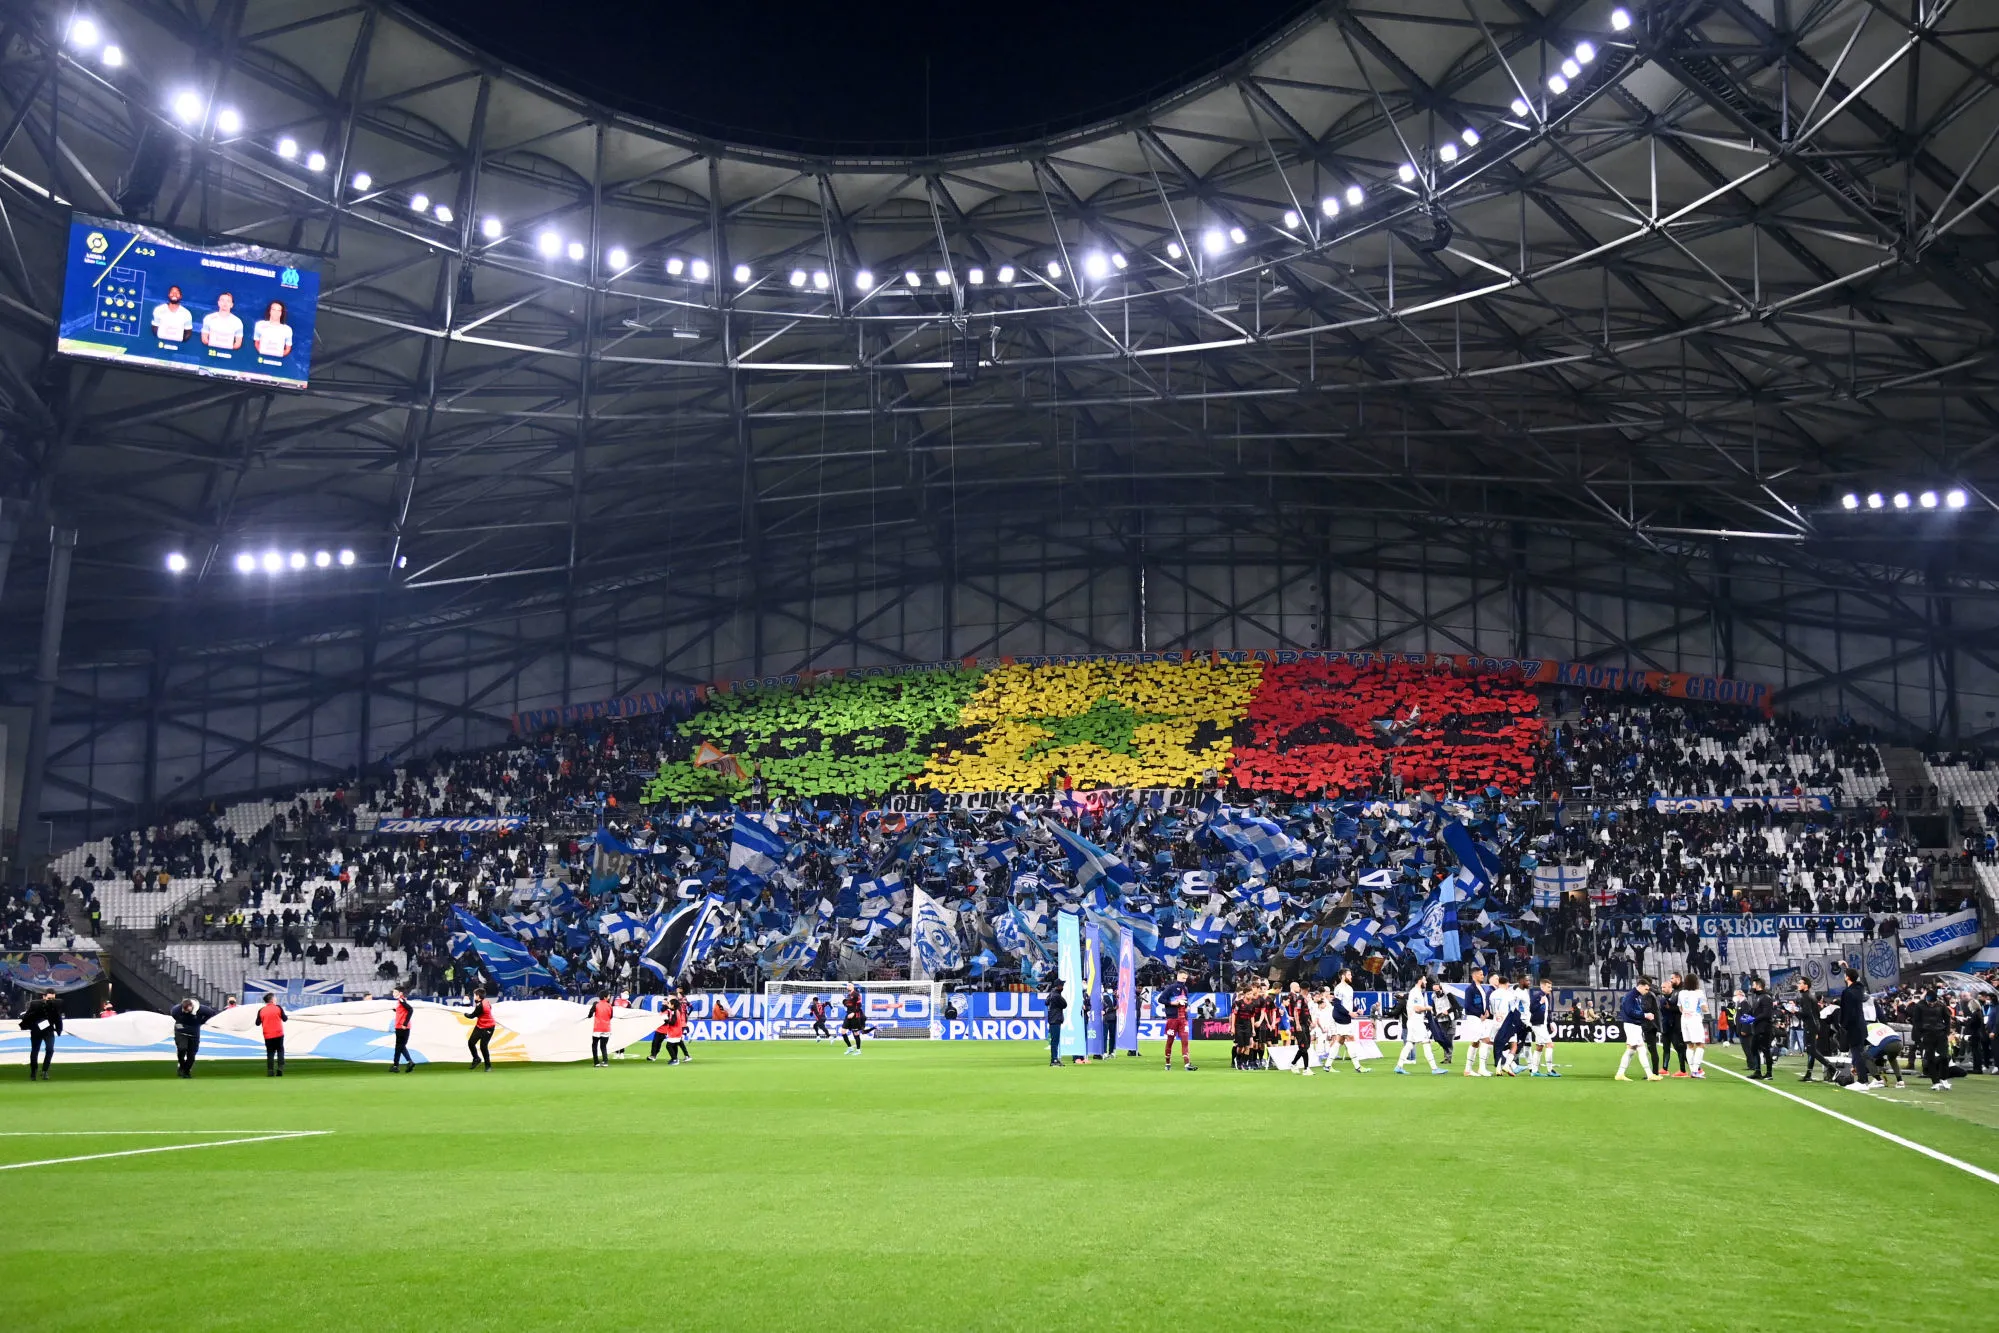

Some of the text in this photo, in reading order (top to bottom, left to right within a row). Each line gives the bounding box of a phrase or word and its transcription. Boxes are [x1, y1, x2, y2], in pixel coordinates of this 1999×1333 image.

[1557, 662, 1645, 692] KAOTIC
[1685, 676, 1767, 701] GROUP
[379, 819, 442, 832] ZONE
[949, 1020, 1049, 1040] PARION
